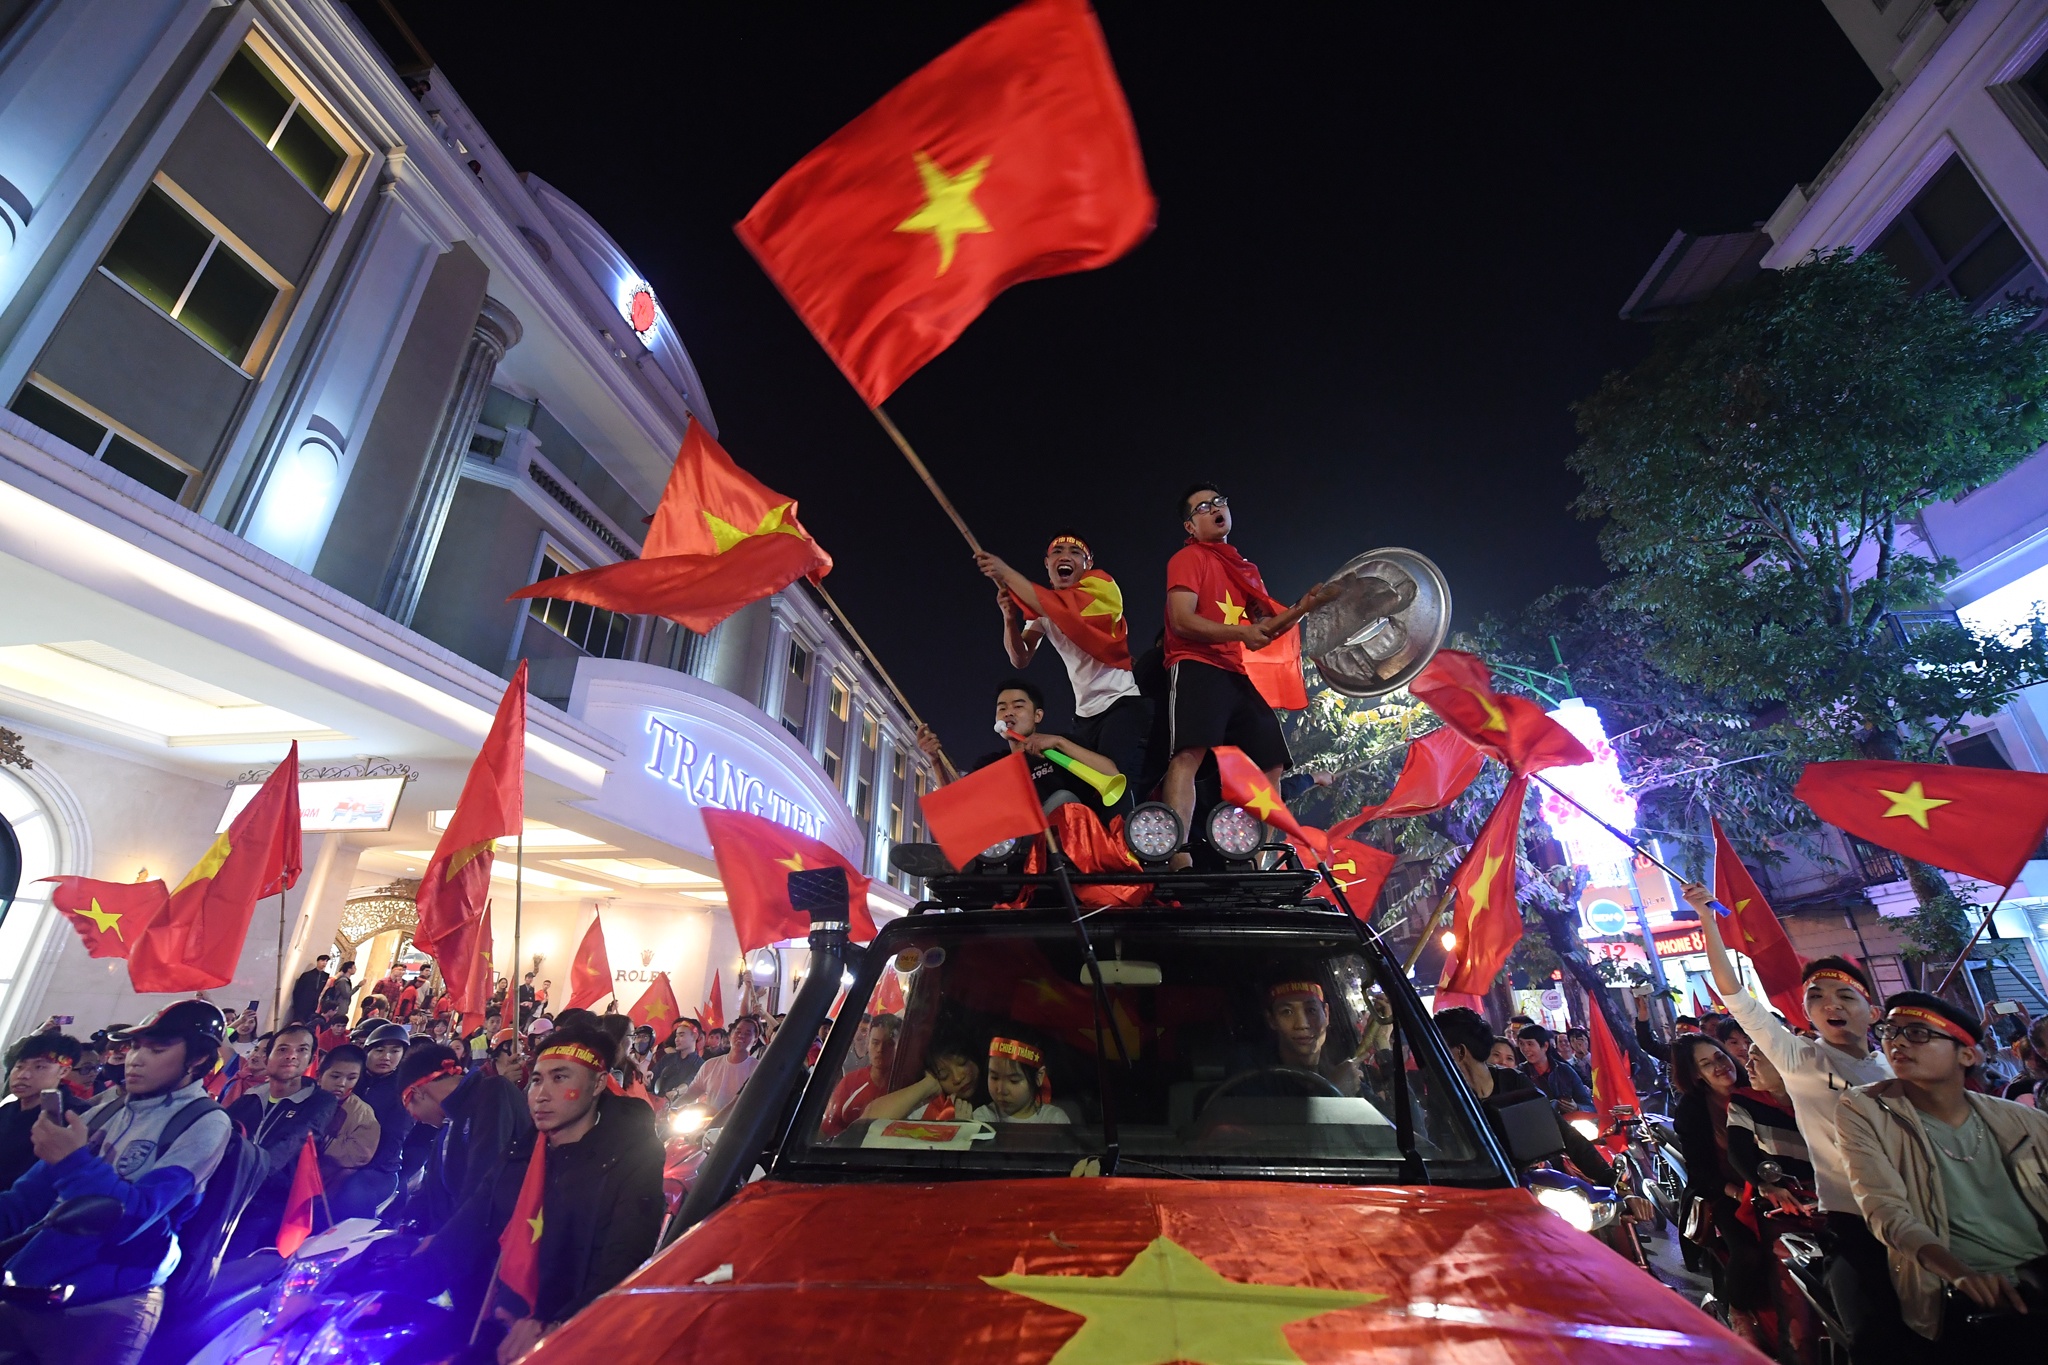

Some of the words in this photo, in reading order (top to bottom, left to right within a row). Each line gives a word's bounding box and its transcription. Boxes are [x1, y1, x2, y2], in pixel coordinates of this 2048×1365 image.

[645, 715, 765, 814] TRANG
[1031, 765, 1054, 780] 1984
[1656, 936, 1691, 955] PHONE
